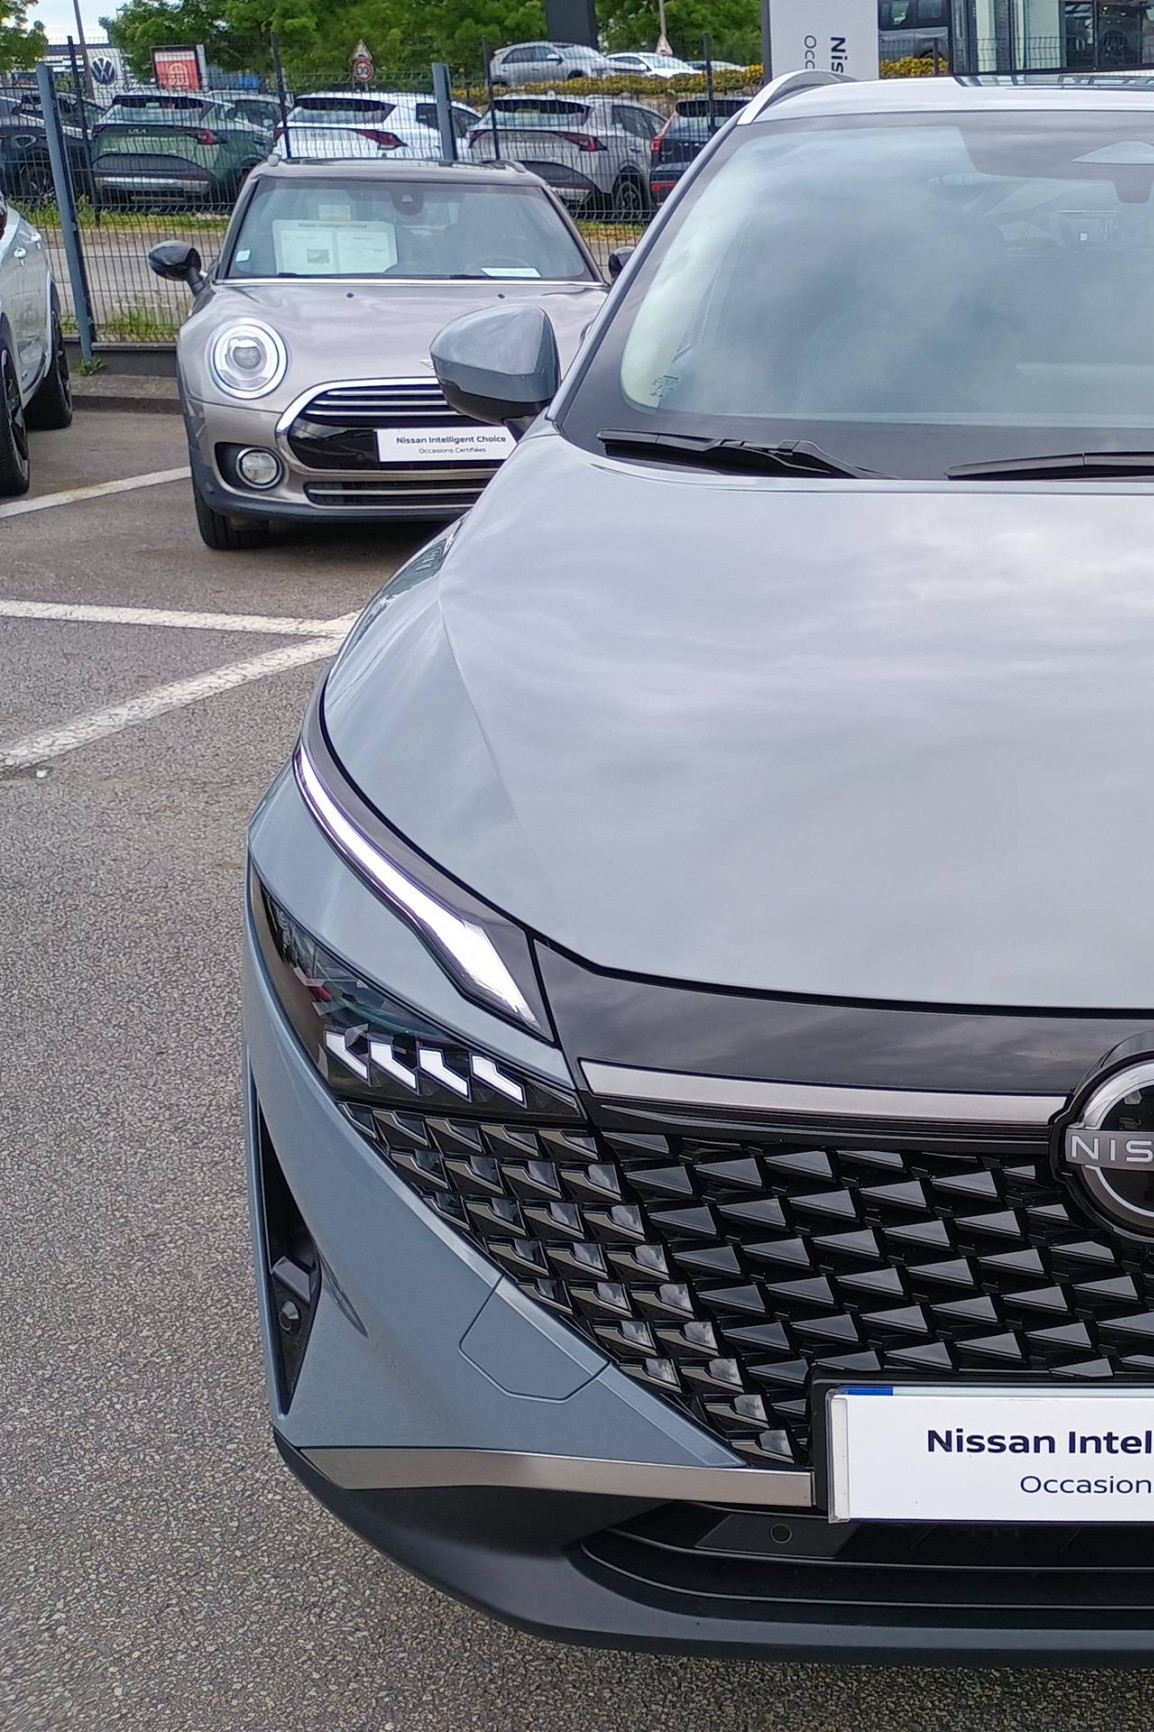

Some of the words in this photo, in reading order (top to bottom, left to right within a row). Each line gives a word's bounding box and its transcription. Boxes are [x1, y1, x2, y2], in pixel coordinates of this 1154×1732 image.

[396, 436, 428, 444] Nissan
[429, 435, 475, 445] Intelligent
[476, 435, 507, 443] Choice
[927, 1427, 1056, 1454] Nissan
